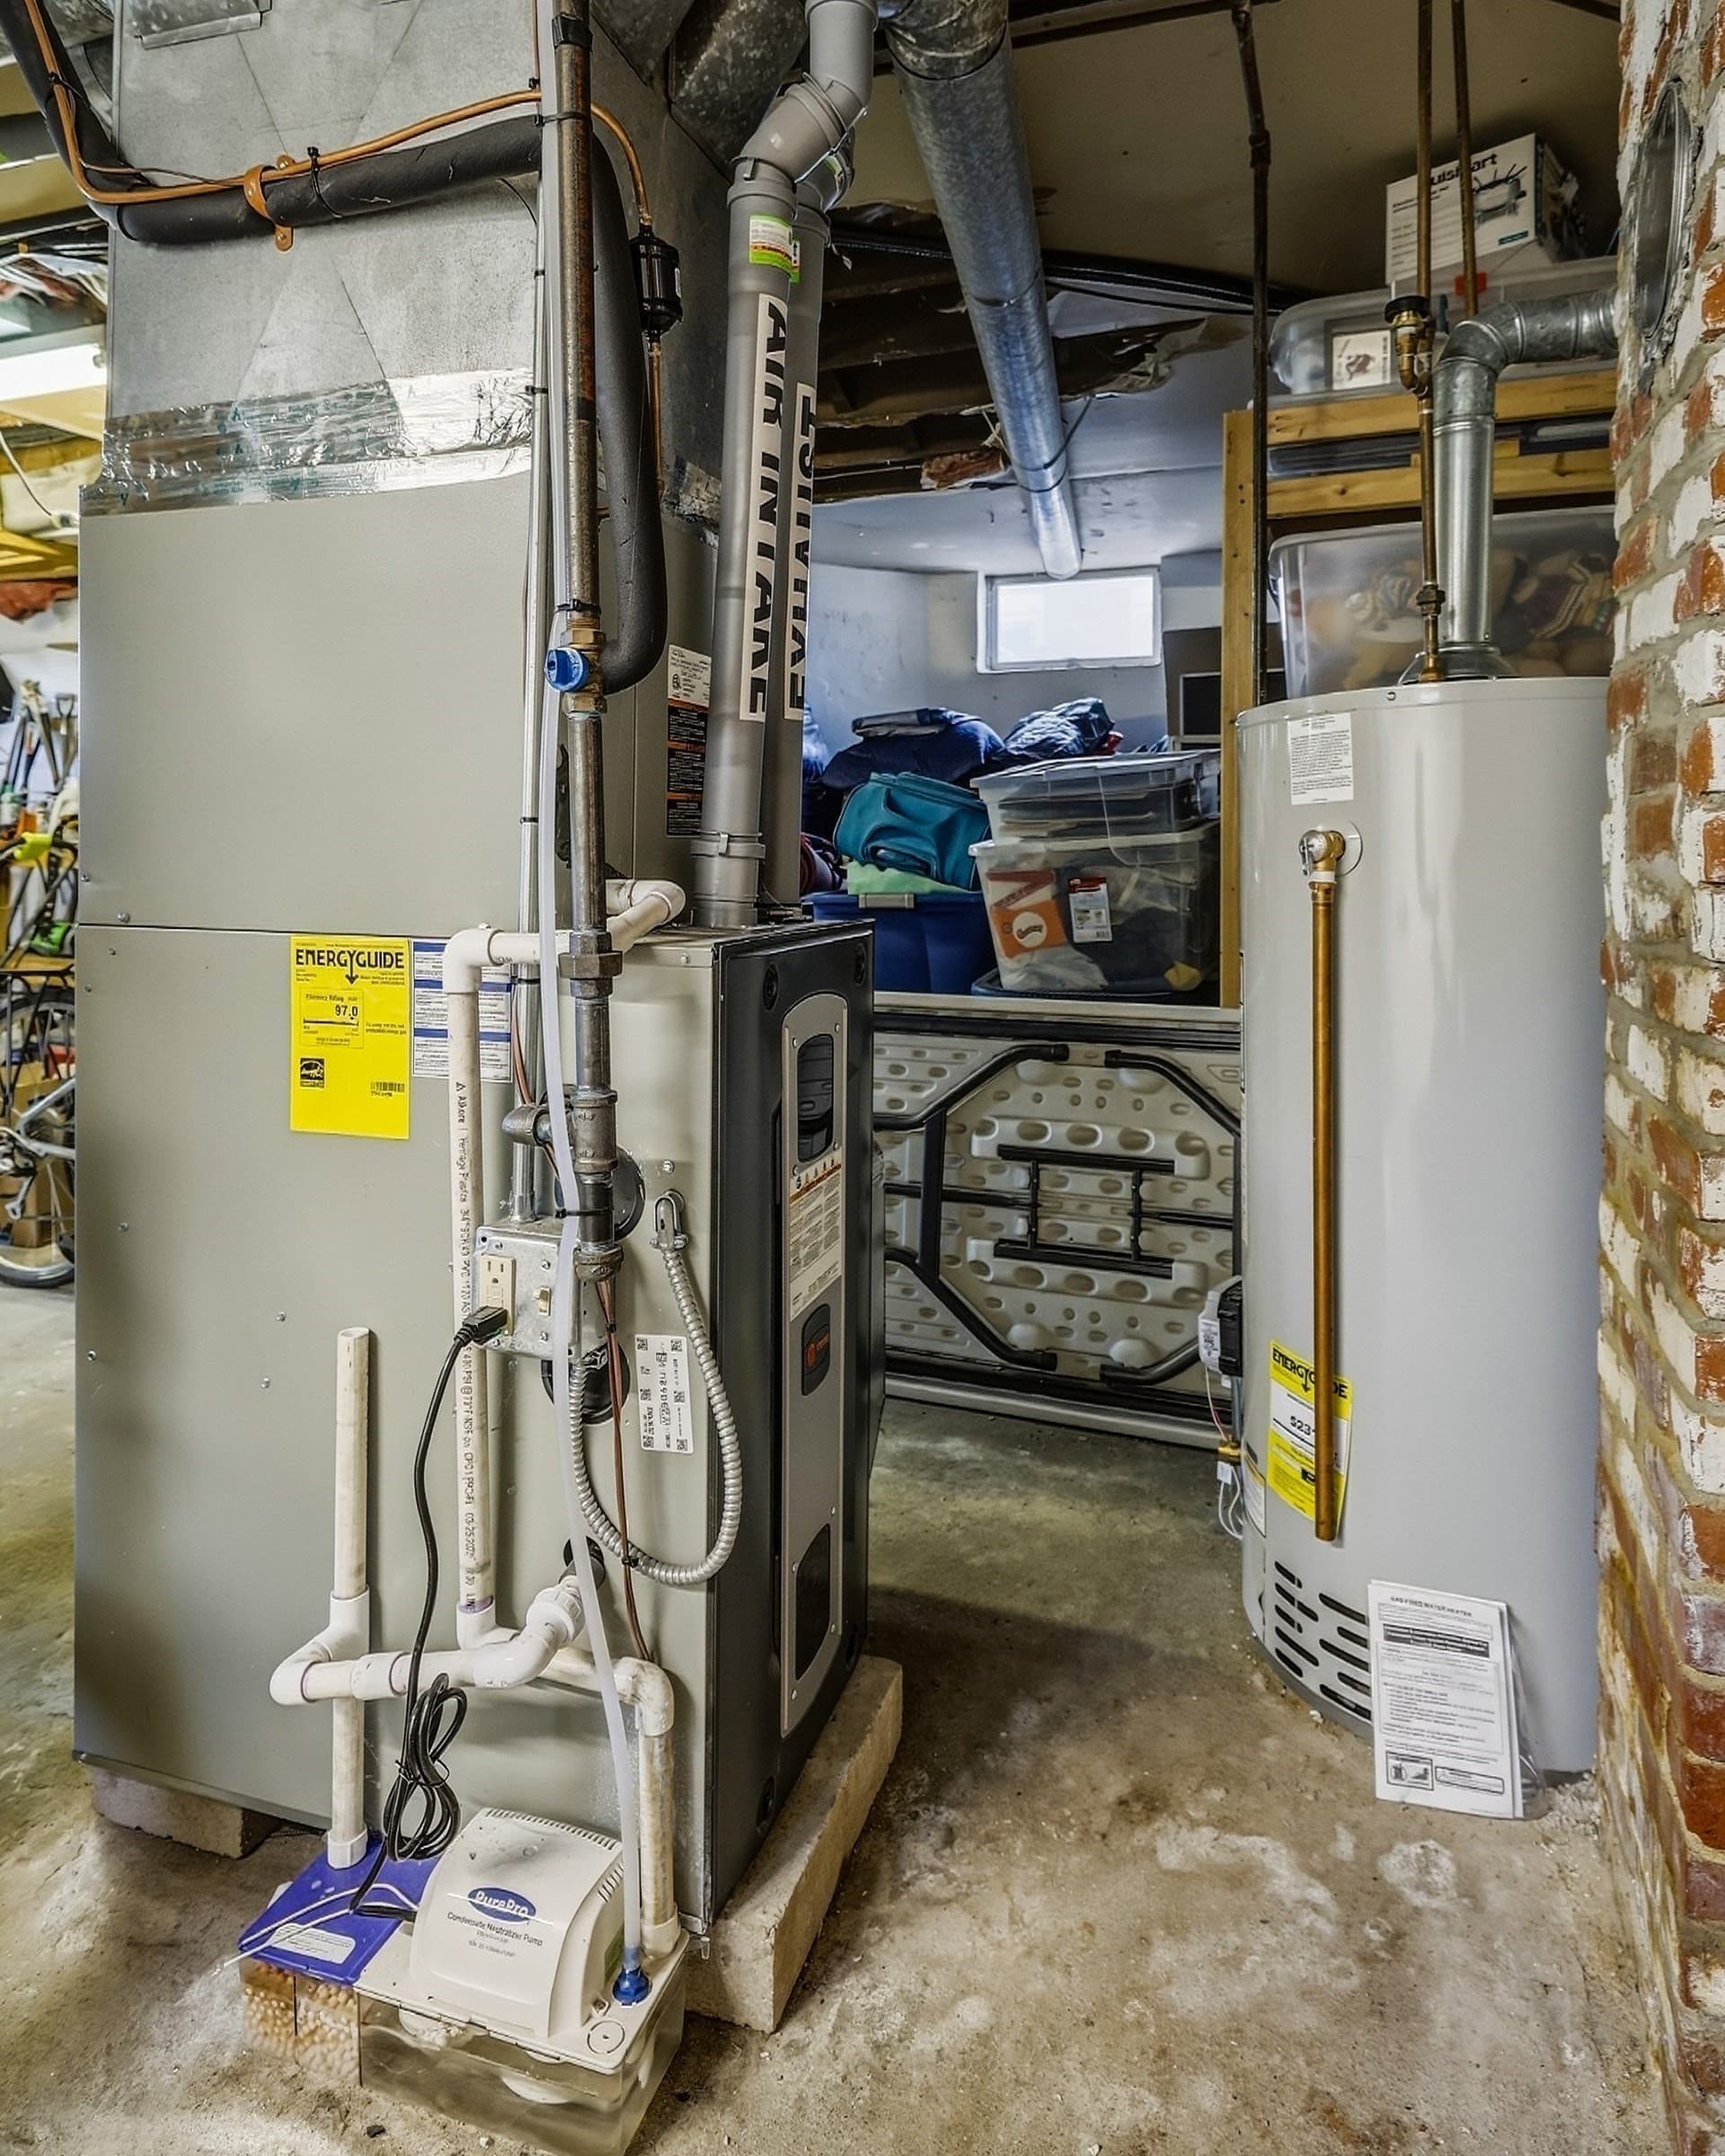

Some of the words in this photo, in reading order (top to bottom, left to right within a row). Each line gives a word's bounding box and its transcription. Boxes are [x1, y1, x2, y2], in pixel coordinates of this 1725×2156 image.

[1429, 153, 1498, 186] uisiart
[763, 301, 787, 429] AIR
[789, 394, 816, 708] EXHAUST
[748, 452, 780, 713] INTAKE
[296, 949, 404, 970] ENERGYGUIDE
[335, 1004, 358, 1017] 97.0
[1272, 1348, 1348, 1399] ENERGYGDE
[474, 1890, 529, 1916] PurePro
[523, 1933, 544, 1947] Pump
